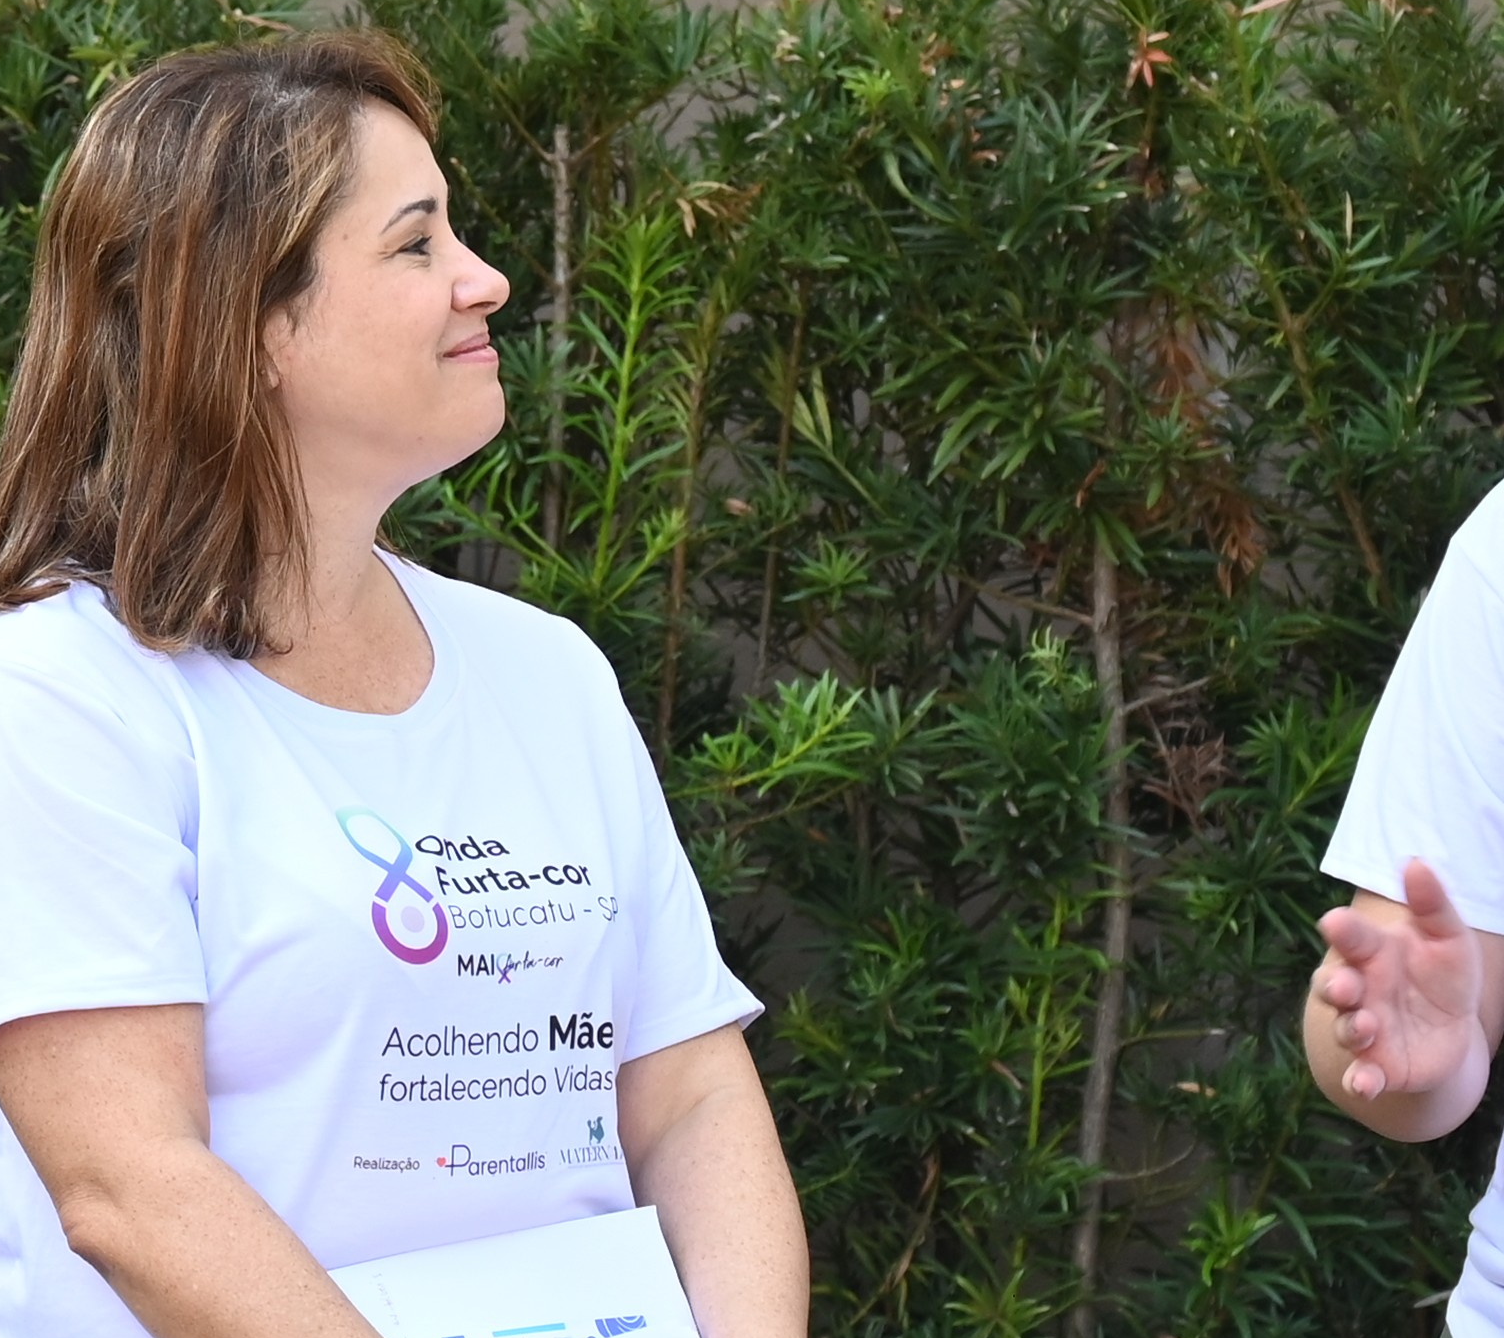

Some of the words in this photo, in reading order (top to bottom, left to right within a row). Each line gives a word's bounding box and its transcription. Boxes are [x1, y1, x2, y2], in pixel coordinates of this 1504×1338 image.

[415, 835, 510, 863] Onda
[435, 862, 592, 897] Furta-cor
[448, 898, 576, 930] Botucatu
[381, 1023, 539, 1058] Acolhendo
[380, 1069, 547, 1102] fortalecendo
[554, 1064, 614, 1094] Vidas
[353, 1156, 420, 1174] Realização
[445, 1144, 546, 1177] Parentallis
